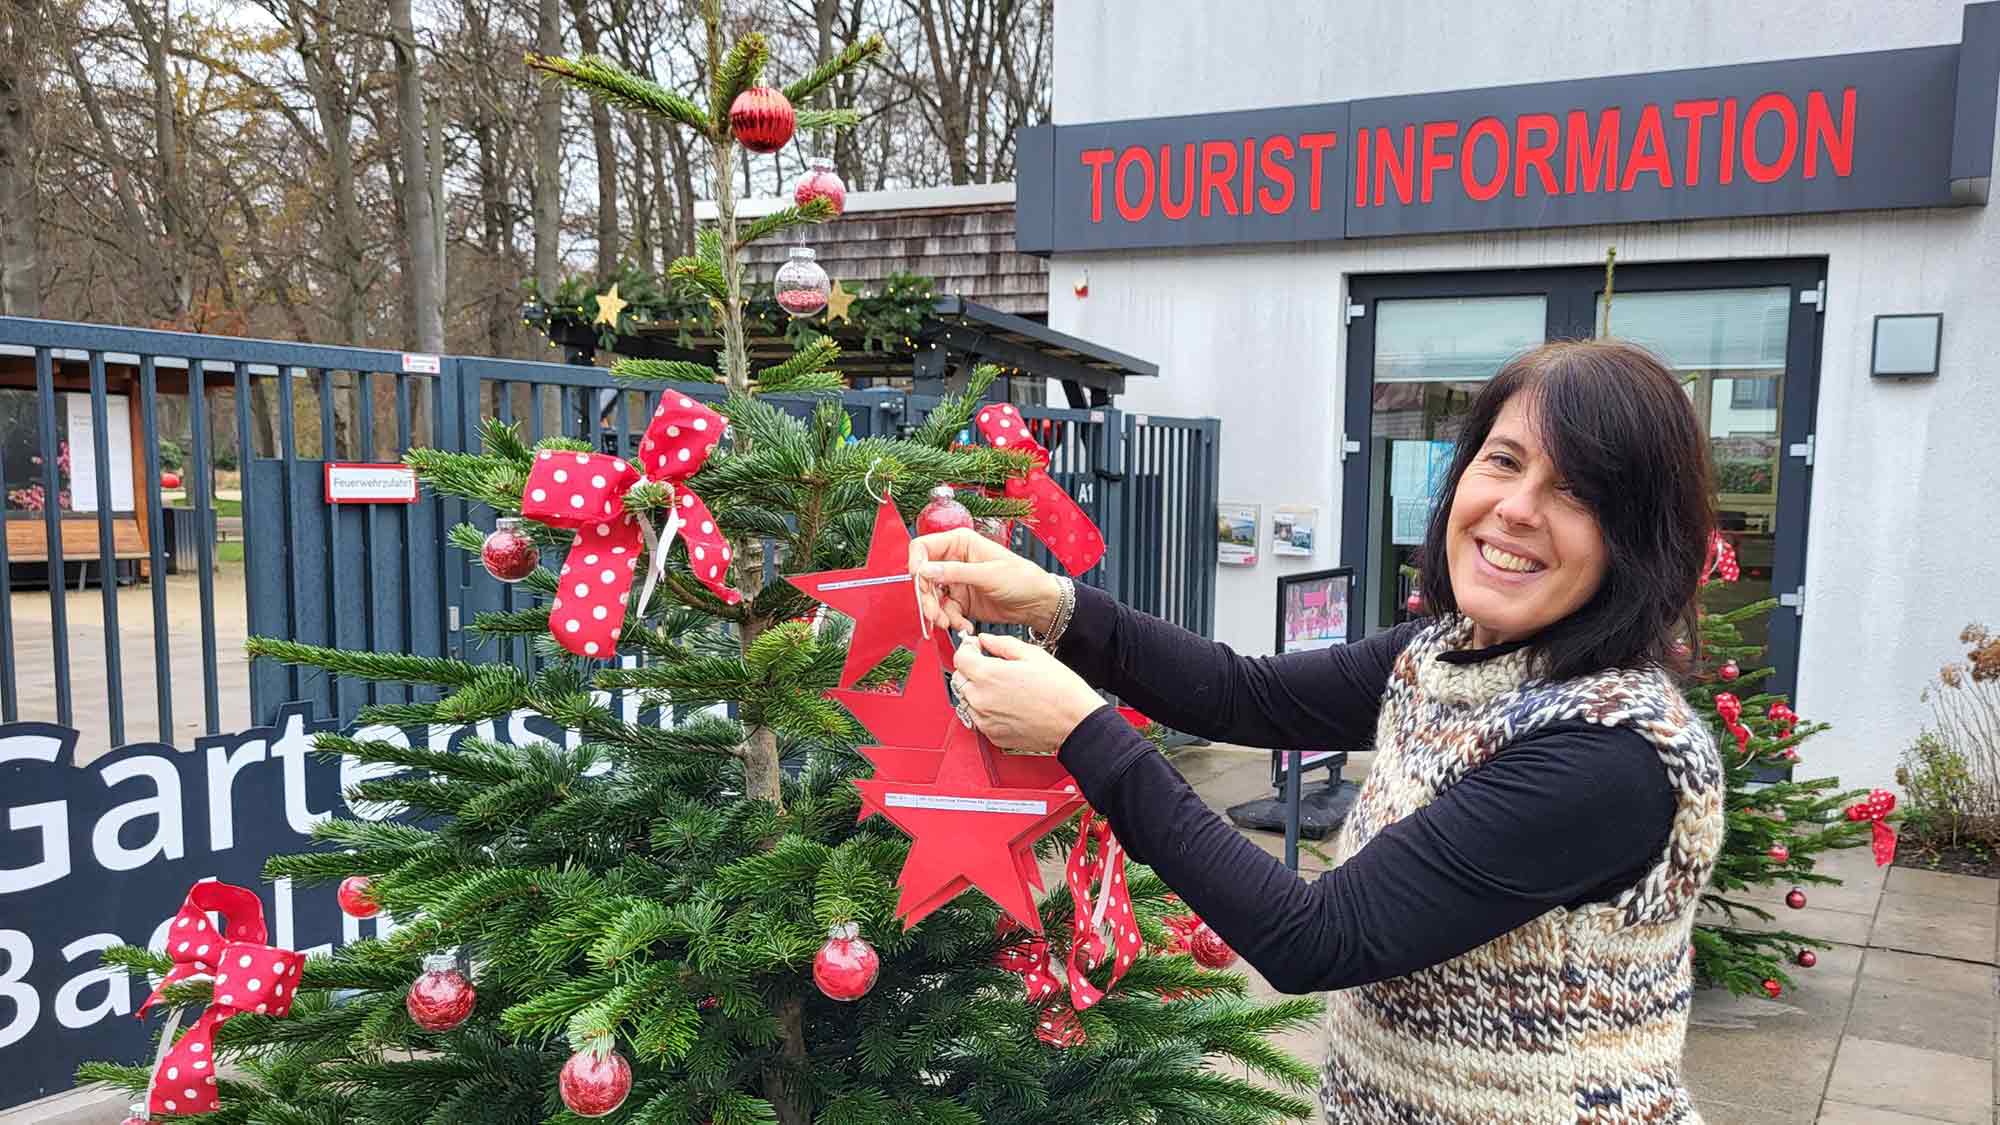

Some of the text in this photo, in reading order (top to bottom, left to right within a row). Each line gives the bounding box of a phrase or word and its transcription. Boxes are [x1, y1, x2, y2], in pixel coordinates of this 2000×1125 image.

[1081, 88, 1857, 223] TOURIST INFORMATION
[334, 477, 412, 489] Feuerwehrzufahrt
[1078, 483, 1093, 503] A1
